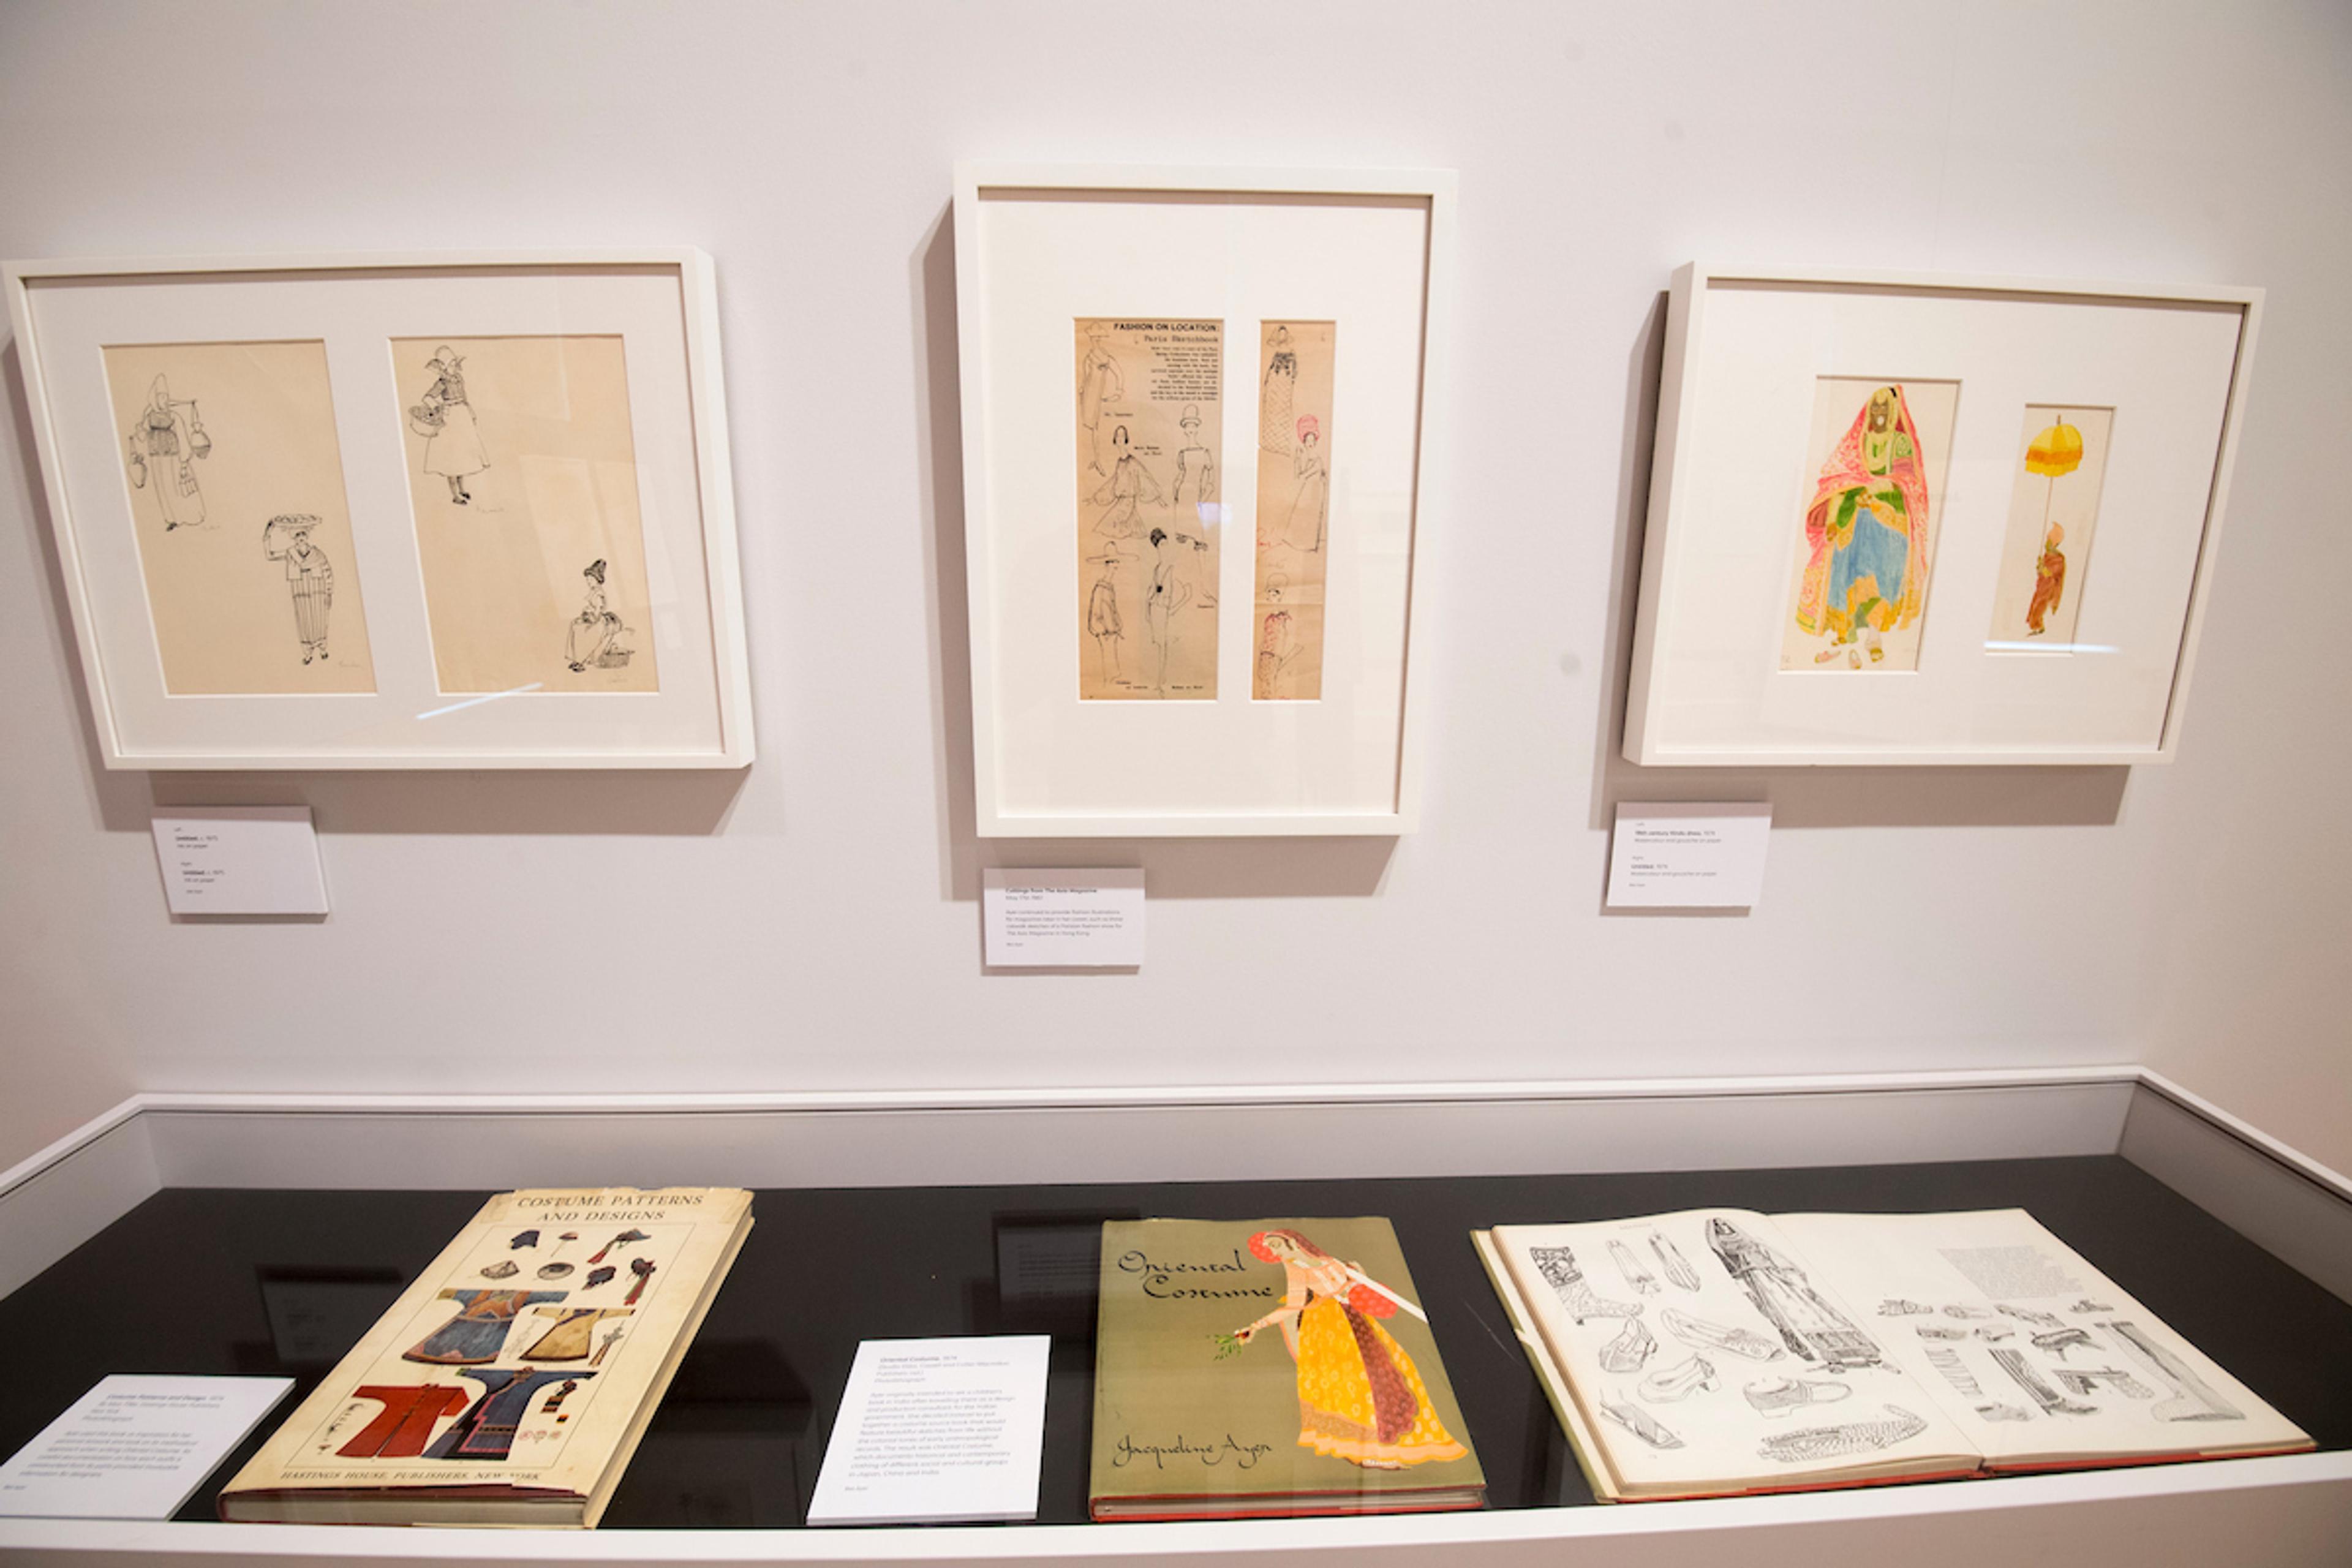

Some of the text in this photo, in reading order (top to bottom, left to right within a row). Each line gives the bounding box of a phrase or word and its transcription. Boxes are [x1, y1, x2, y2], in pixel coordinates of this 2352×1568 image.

[1114, 323, 1153, 331] FASHION
[1155, 323, 1169, 331] ON
[517, 1195, 704, 1207] COSTUME PATTERNS
[537, 1211, 666, 1221] AND DESIGNS
[1118, 1249, 1246, 1280] Oriental
[1143, 1275, 1273, 1298] Costume
[1112, 1434, 1213, 1469] Jacqueline
[281, 1471, 342, 1480] HASTINGS
[474, 1471, 505, 1480] NEW
